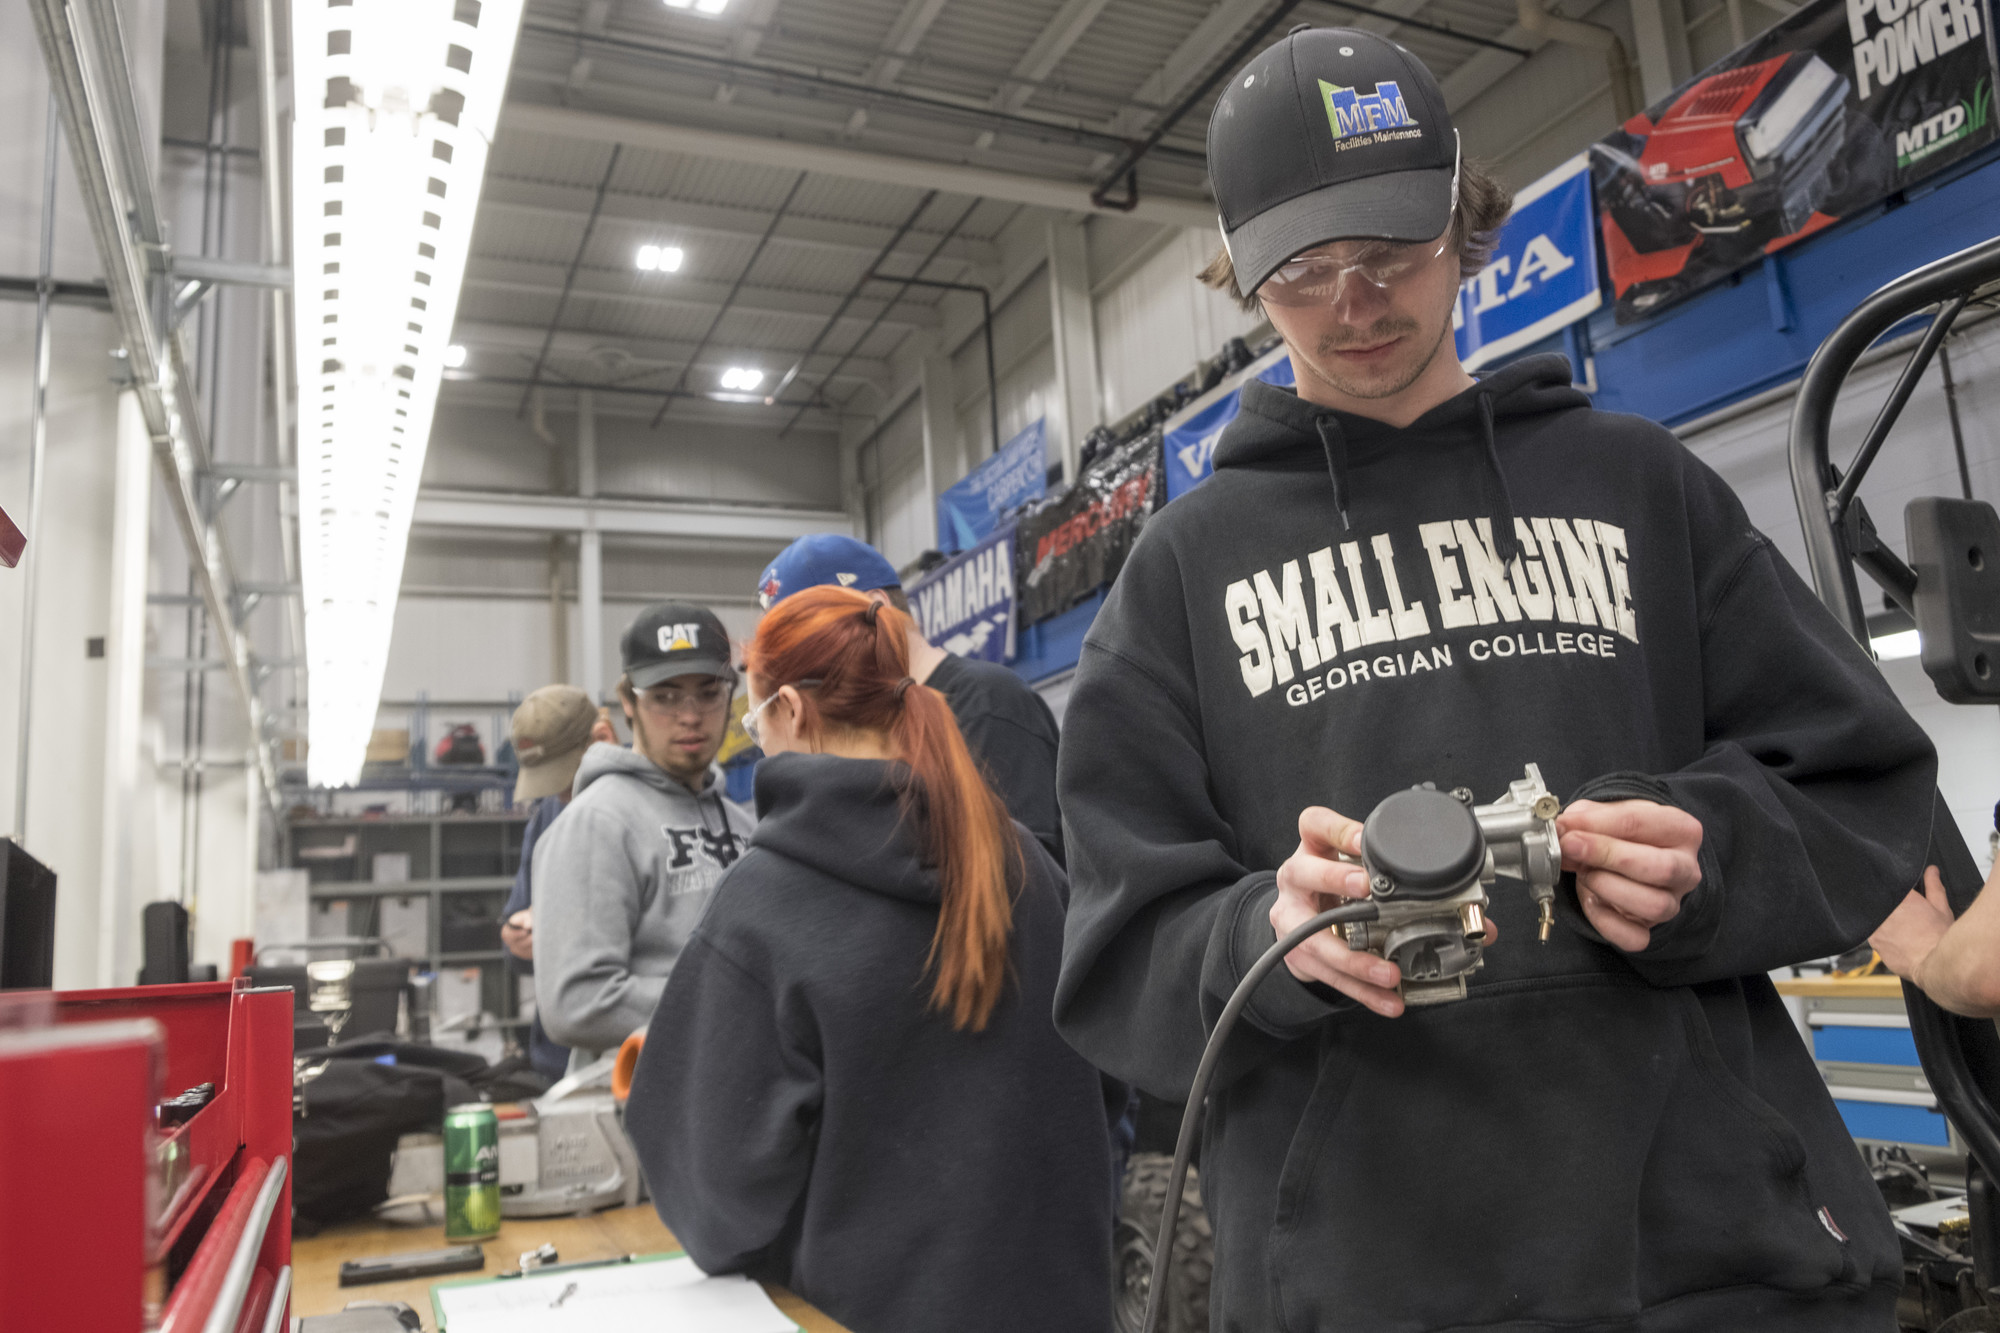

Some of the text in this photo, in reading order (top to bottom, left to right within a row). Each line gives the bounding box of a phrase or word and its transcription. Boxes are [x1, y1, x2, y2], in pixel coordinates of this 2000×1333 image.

[1853, 0, 1982, 100] POWER
[1335, 128, 1422, 152] Facilities Maintenance
[1336, 96, 1409, 136] MFM
[1896, 105, 1965, 157] MTD
[919, 539, 1013, 640] YAMAHA
[1225, 516, 1640, 698] SMALL ENGINE
[657, 623, 701, 652] CAT
[1286, 632, 1617, 707] GEORGIAN COLLEGE
